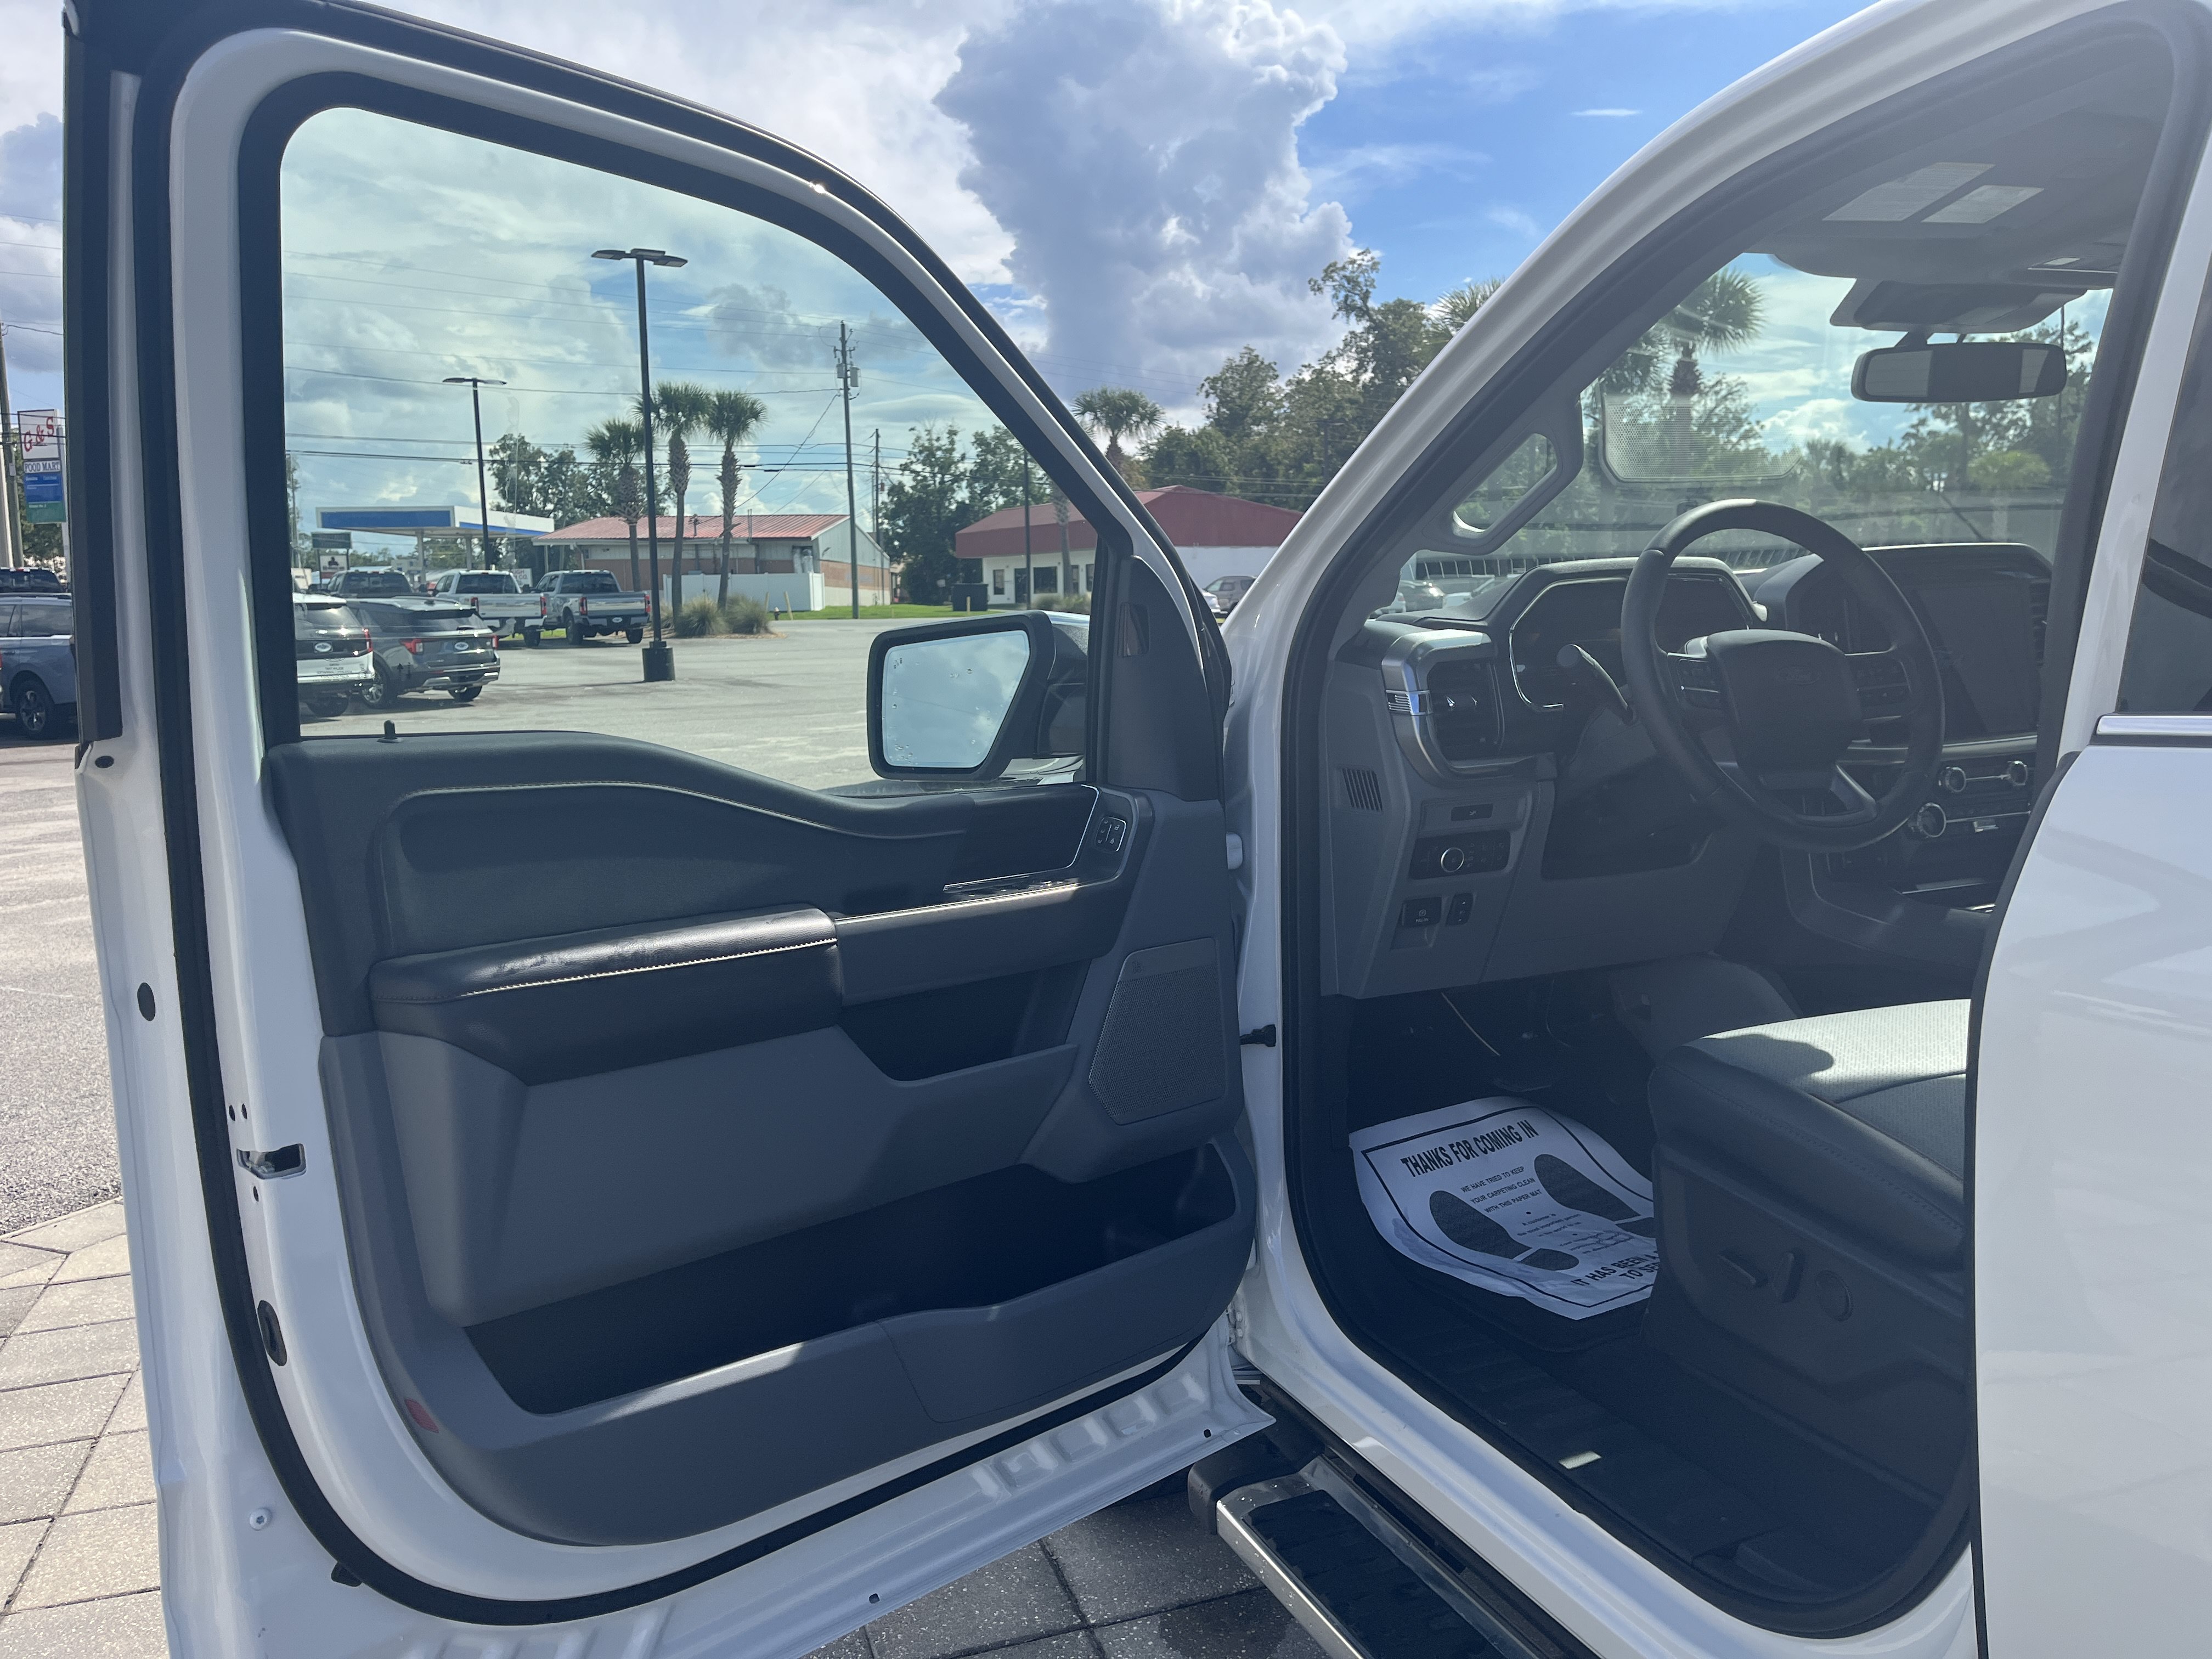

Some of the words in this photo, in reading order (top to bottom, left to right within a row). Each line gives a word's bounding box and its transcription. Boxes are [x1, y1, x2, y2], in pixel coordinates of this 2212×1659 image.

[24, 430, 32, 452] G
[36, 425, 44, 444] &
[46, 416, 54, 437] S
[25, 463, 41, 473] FOOD
[42, 462, 59, 471] MART
[1400, 1146, 1453, 1177] THANKS
[1448, 1139, 1479, 1163] FOR
[1472, 1125, 1523, 1155] COMING
[1517, 1120, 1539, 1139] IN
[1470, 1180, 1487, 1190] HAVE
[1486, 1175, 1502, 1184] TRIED
[1510, 1166, 1525, 1175] KEEP
[1470, 1195, 1487, 1204] YOUR
[1486, 1184, 1517, 1198] CARPETING
[1517, 1177, 1536, 1187] CLEAN
[1484, 1204, 1500, 1213] WITH
[1499, 1200, 1512, 1208] THIS
[1511, 1194, 1531, 1204] PAPER
[1585, 1266, 1617, 1281] HAS
[1611, 1256, 1650, 1268] BEEN
[1618, 1269, 1643, 1279] TO
